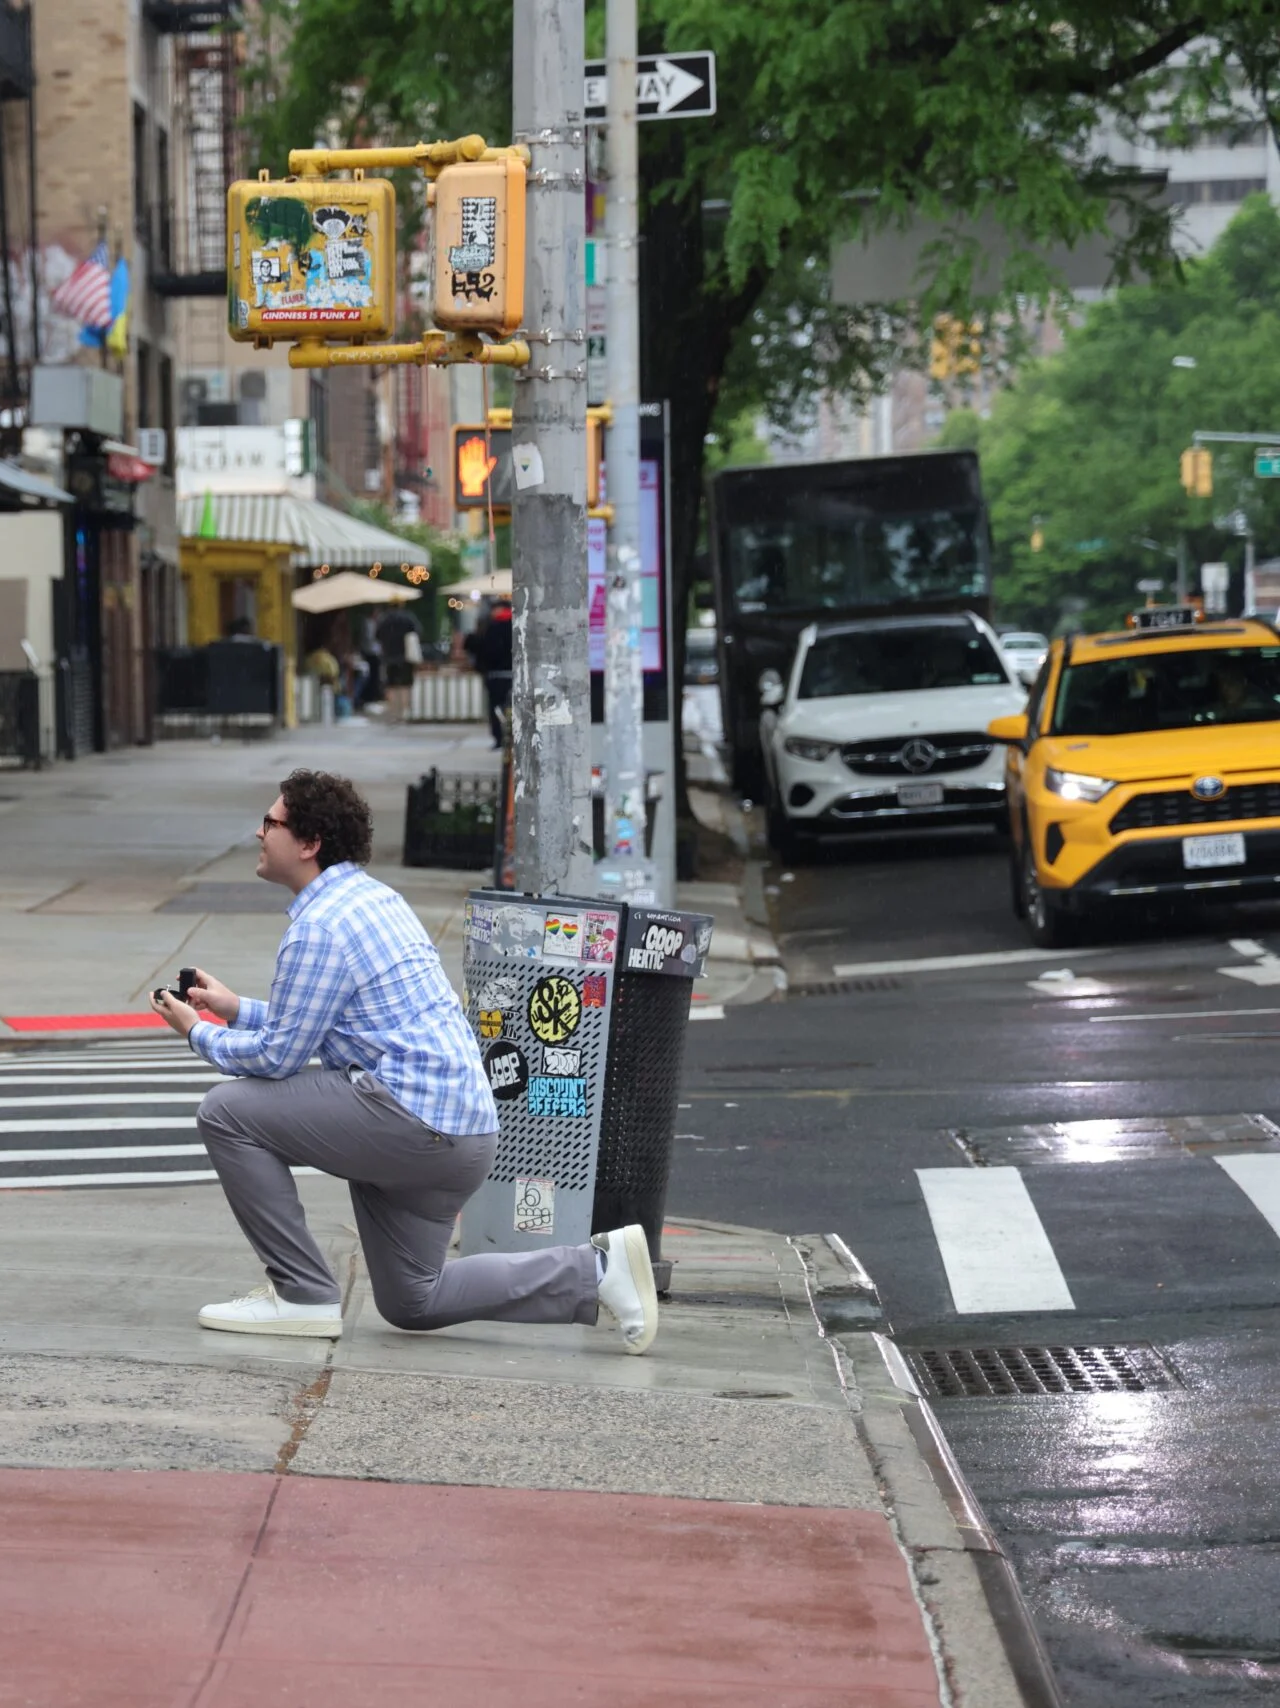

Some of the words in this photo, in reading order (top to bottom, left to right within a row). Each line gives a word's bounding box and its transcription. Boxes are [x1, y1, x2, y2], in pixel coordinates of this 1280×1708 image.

[262, 311, 307, 320] KINDNESS
[309, 311, 318, 320] IS
[320, 311, 346, 320] PUNK
[348, 311, 360, 320] AF
[528, 1077, 586, 1098] DISCOUNT
